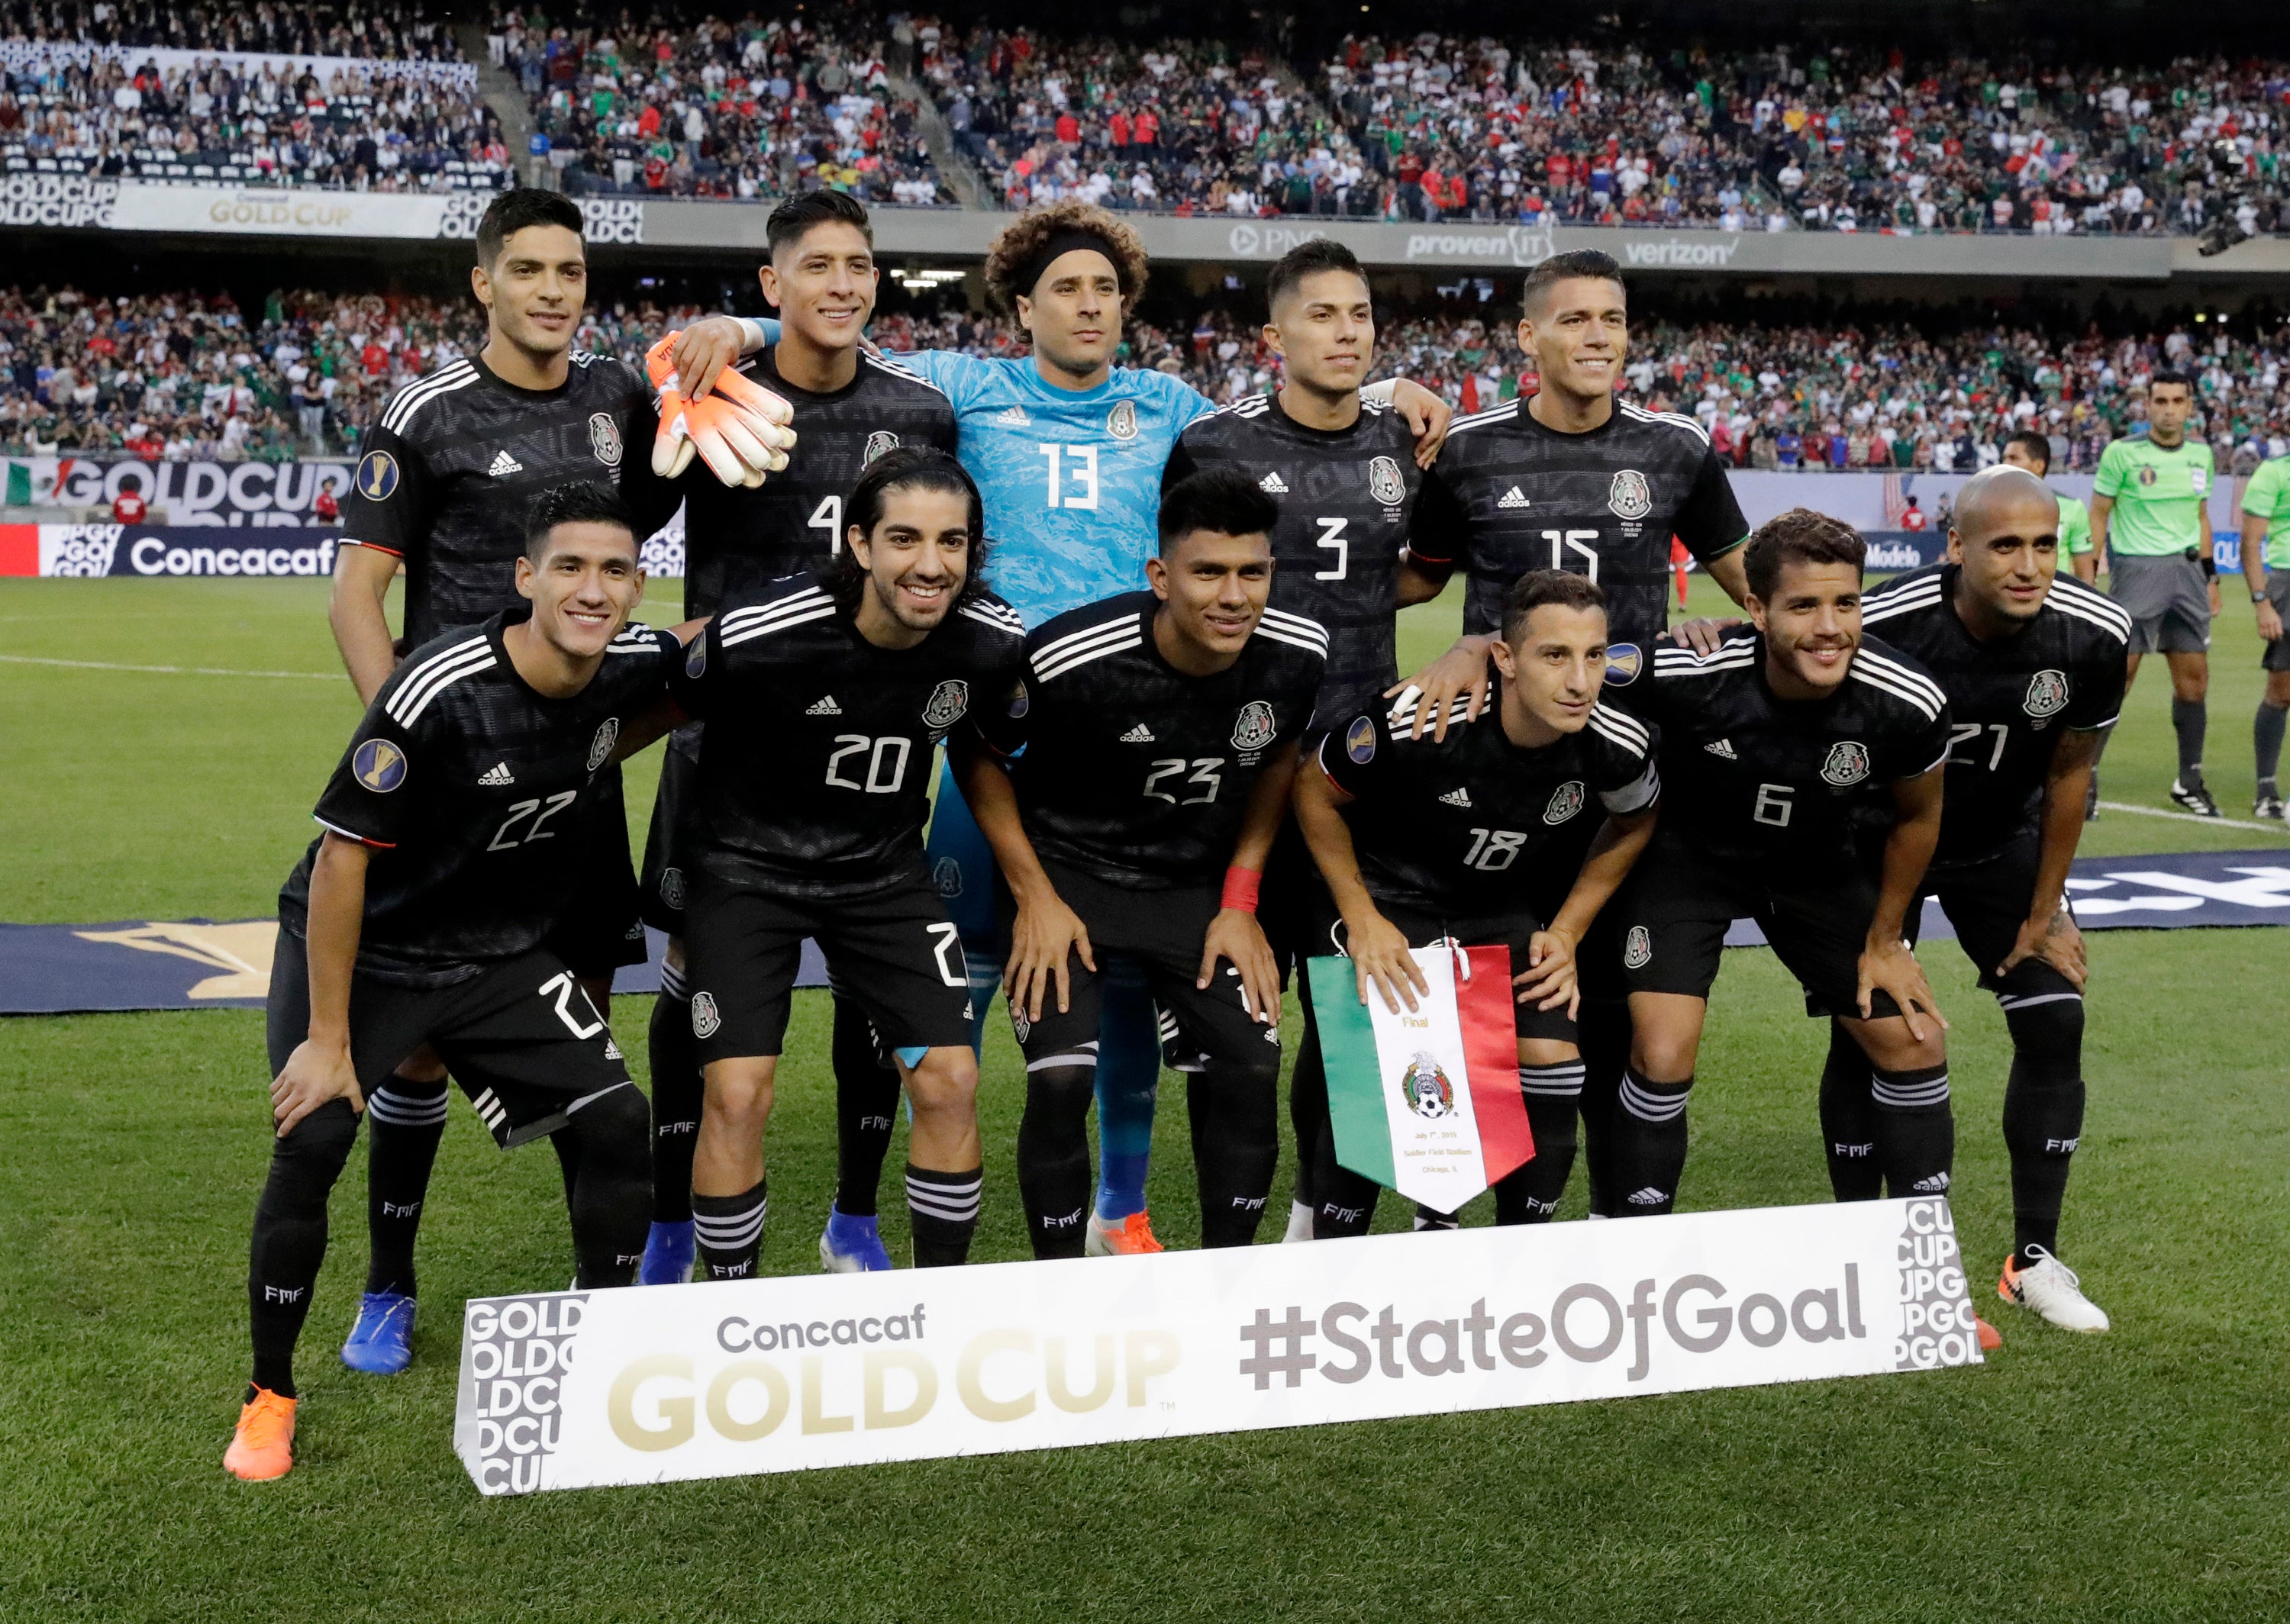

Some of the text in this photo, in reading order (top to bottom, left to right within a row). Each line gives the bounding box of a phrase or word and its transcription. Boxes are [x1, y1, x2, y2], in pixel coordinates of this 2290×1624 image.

[210, 199, 353, 227] GOLD CUP
[1406, 234, 1507, 259] proven
[1626, 237, 1728, 265] verizon
[489, 462, 523, 476] adidas
[1039, 443, 1098, 509] 13
[1498, 498, 1530, 508] adidas
[808, 495, 842, 559] 4
[131, 537, 334, 575] Concacaf
[1315, 517, 1349, 580] 3
[1541, 530, 1599, 586] 15
[805, 707, 843, 715] adidas
[1119, 733, 1156, 743] adidas
[1704, 745, 1738, 760] adidas
[825, 734, 911, 793] 20
[478, 775, 515, 785] adidas
[1143, 758, 1225, 806] 23
[1438, 794, 1472, 807] adidas
[1753, 783, 1795, 827] 6
[486, 790, 577, 851] 22
[1463, 827, 1527, 871] 18
[1402, 1017, 1429, 1028] Final
[659, 1121, 696, 1136] FMF
[861, 1116, 892, 1131] FMF
[1835, 1142, 1873, 1157] FMF
[2046, 1137, 2080, 1153] FMF
[383, 1201, 420, 1218] FMF
[1627, 1193, 1670, 1205] adidas
[1043, 1207, 1082, 1229] FMF
[1323, 1202, 1365, 1223] FMF
[713, 1258, 753, 1278] FMF
[265, 1285, 305, 1304] FMF
[718, 1303, 927, 1354] Concacaf
[1240, 1263, 1866, 1390] #StateOfGoal
[608, 1348, 939, 1452] GOLD
[956, 1326, 1182, 1423] CUP
